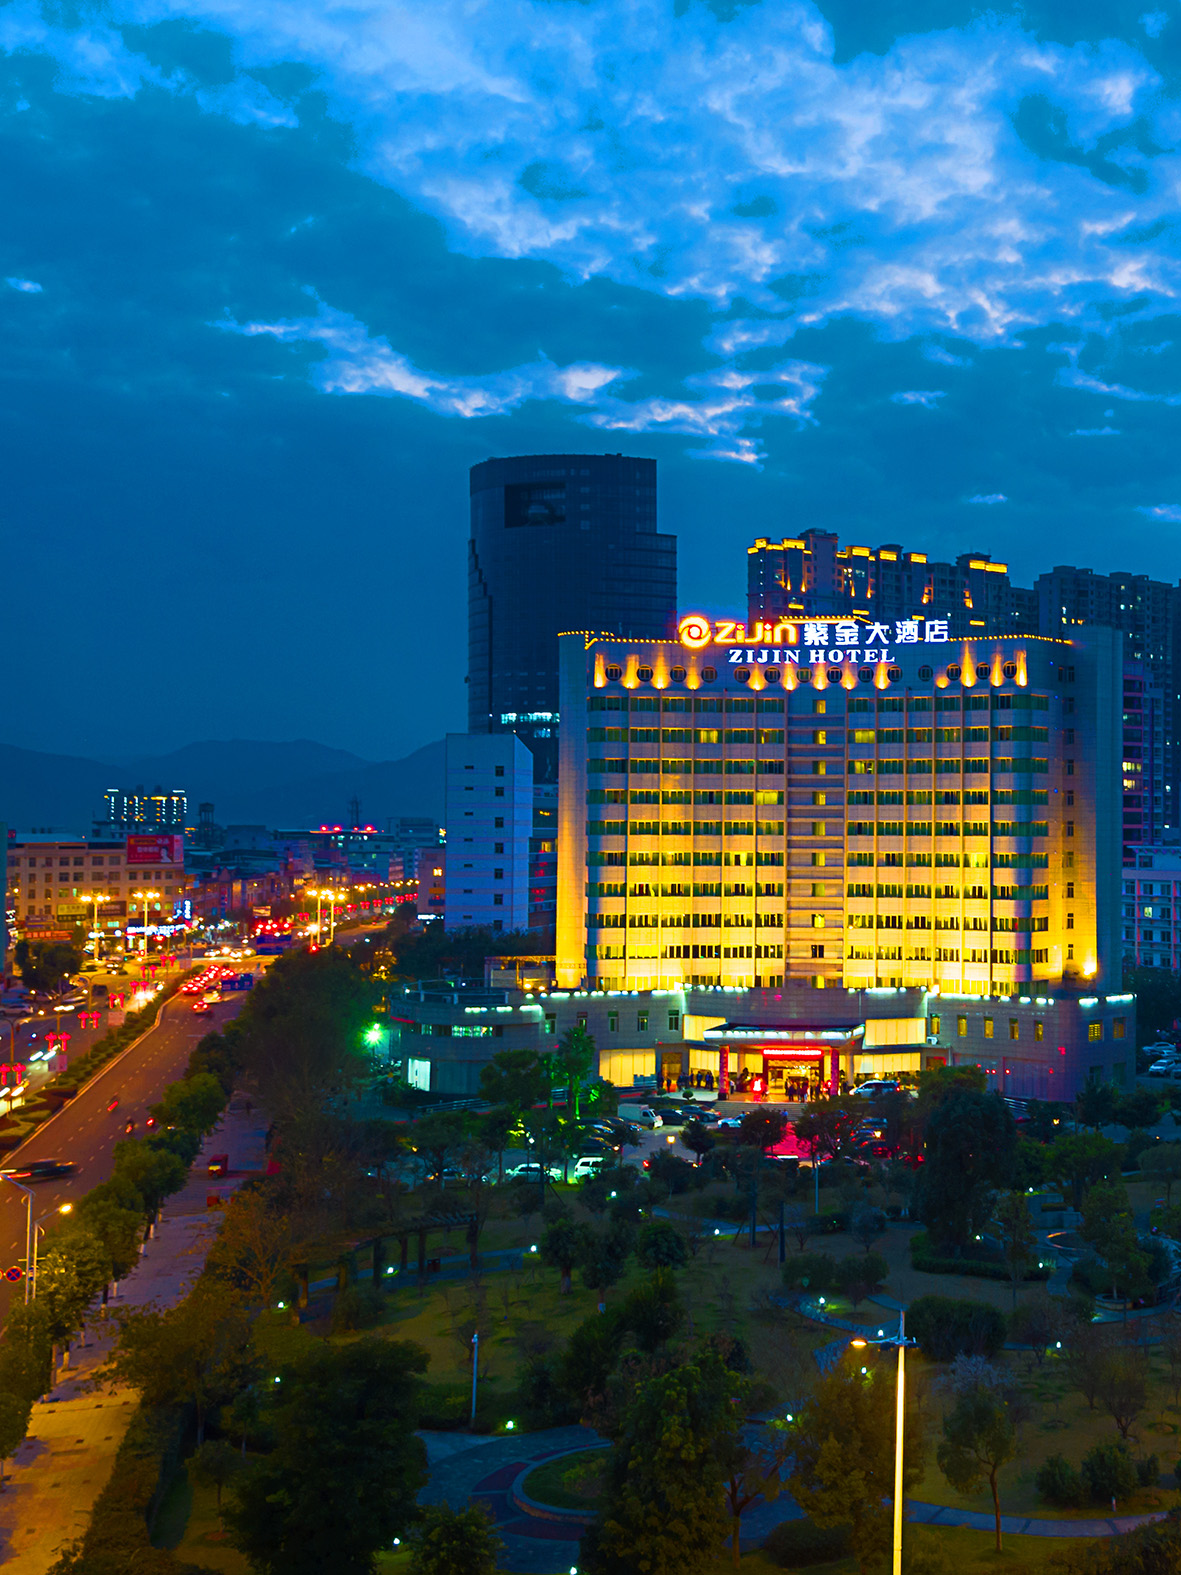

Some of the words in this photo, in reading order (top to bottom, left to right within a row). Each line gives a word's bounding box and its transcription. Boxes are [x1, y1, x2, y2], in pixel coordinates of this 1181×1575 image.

[803, 620, 949, 645] 紫金大酒店
[728, 649, 800, 663] ZIJIN
[808, 649, 895, 663] HOTEL
